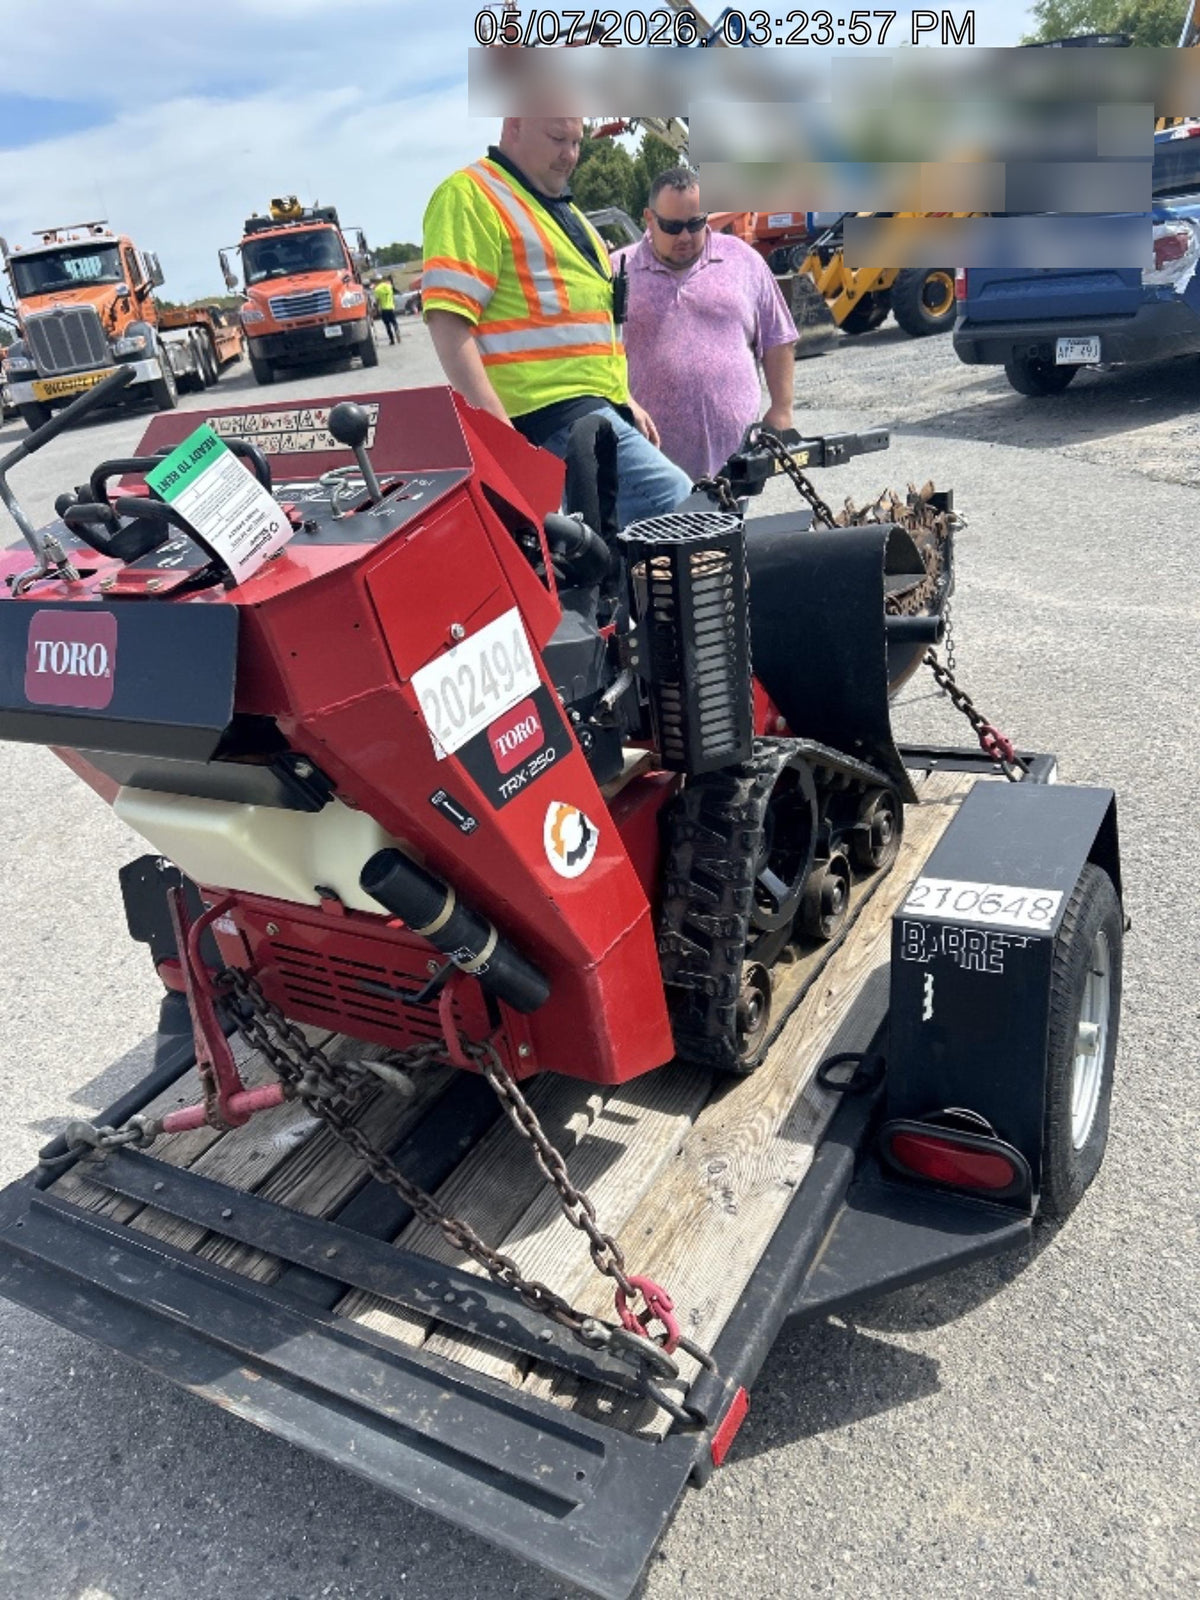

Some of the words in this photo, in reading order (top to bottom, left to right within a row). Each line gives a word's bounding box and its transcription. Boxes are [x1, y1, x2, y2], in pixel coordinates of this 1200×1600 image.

[176, 459, 192, 474] TO
[190, 435, 218, 464] READY
[156, 470, 181, 494] RENT
[34, 641, 108, 677] TORO
[421, 627, 533, 740] 202494
[493, 715, 541, 758] TORO
[905, 885, 1053, 921] 210648
